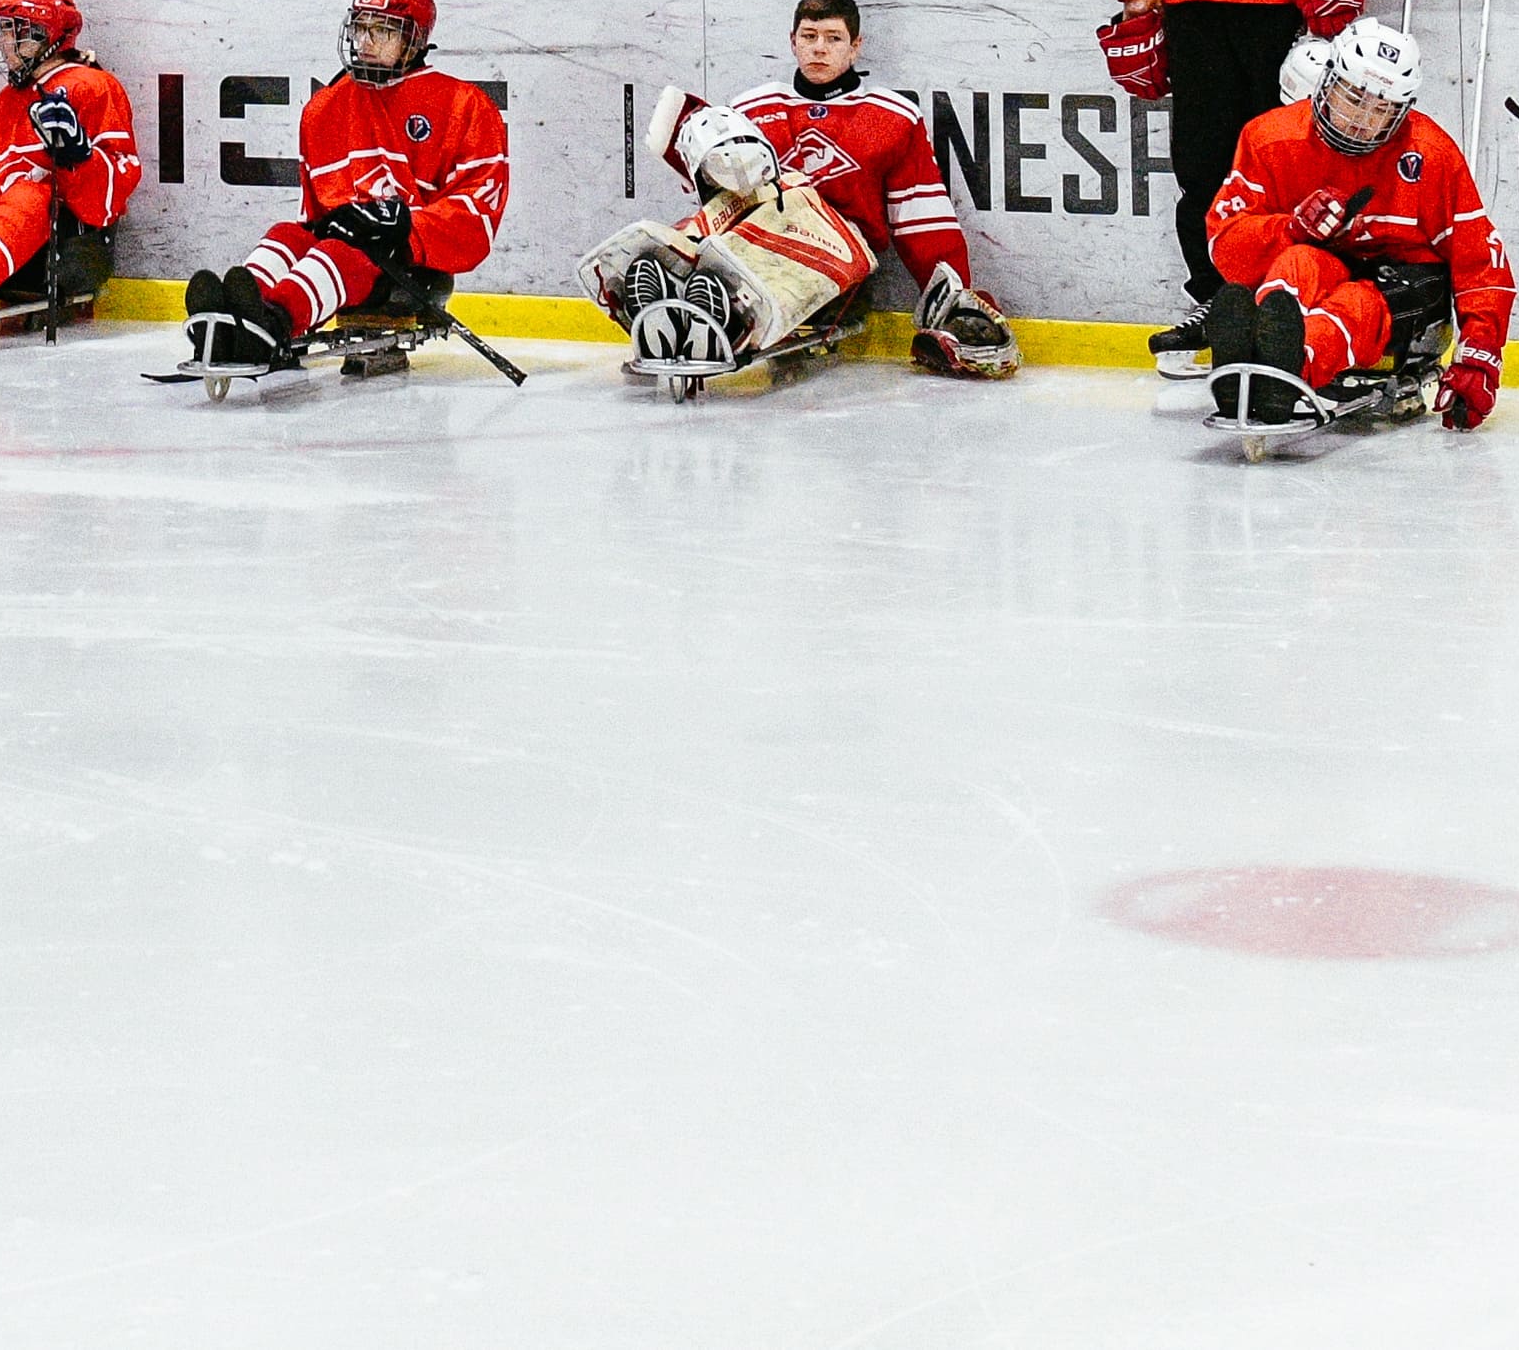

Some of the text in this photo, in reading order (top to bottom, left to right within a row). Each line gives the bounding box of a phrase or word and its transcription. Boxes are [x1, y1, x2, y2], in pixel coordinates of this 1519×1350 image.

[1107, 31, 1164, 58] BAUE
[892, 90, 1176, 216] NESP
[1462, 346, 1503, 369] BAU
